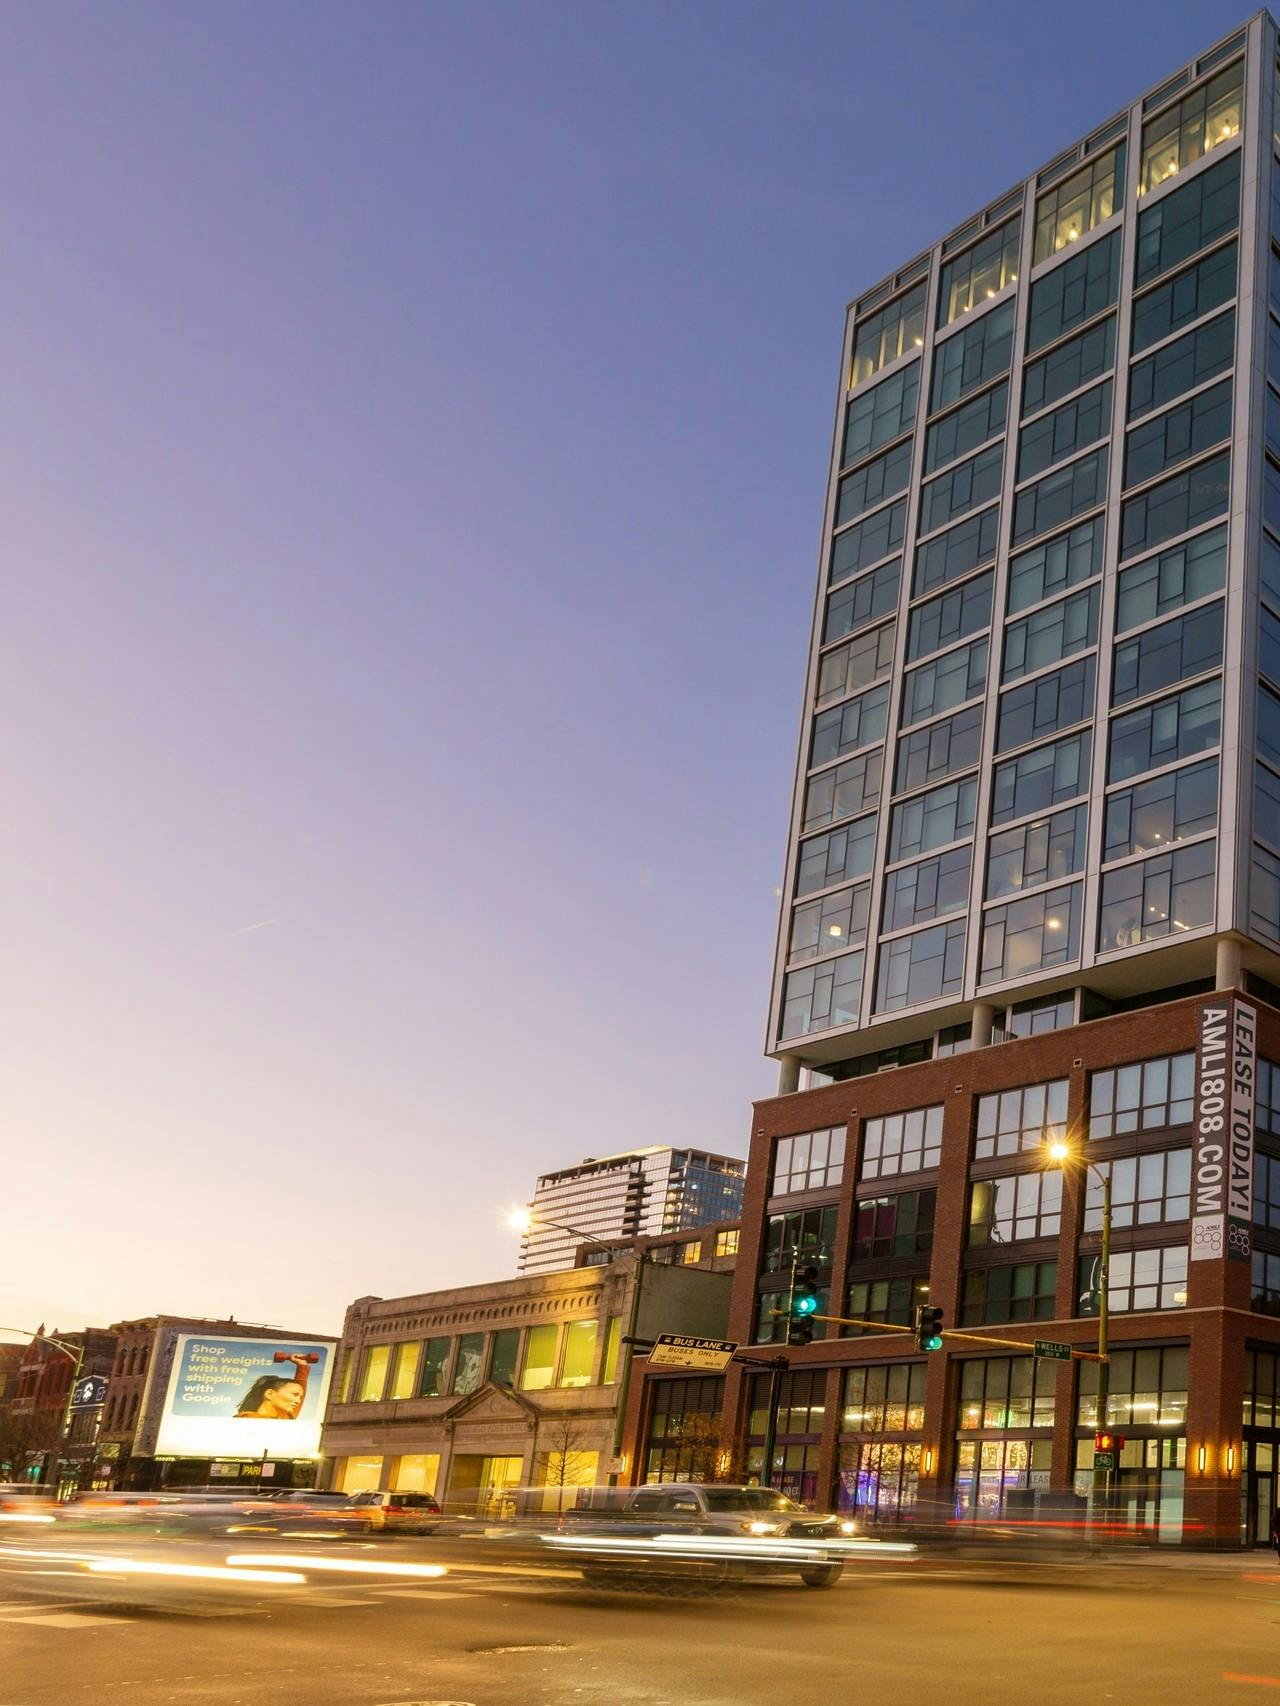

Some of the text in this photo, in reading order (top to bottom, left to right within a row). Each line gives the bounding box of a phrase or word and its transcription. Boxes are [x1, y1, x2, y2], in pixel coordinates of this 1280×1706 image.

[1196, 1008, 1228, 1213] AMLI808.COM
[1230, 1007, 1254, 1213] LEASE TODAY!
[192, 1344, 226, 1355] Shop
[673, 1337, 723, 1350] BUS LANE
[1041, 1343, 1063, 1352] WELLS
[668, 1347, 694, 1355] BUSES
[190, 1353, 273, 1368] free weights
[188, 1363, 249, 1375] with free
[185, 1373, 244, 1386] shipping
[184, 1383, 215, 1393] with
[182, 1392, 232, 1405] Google
